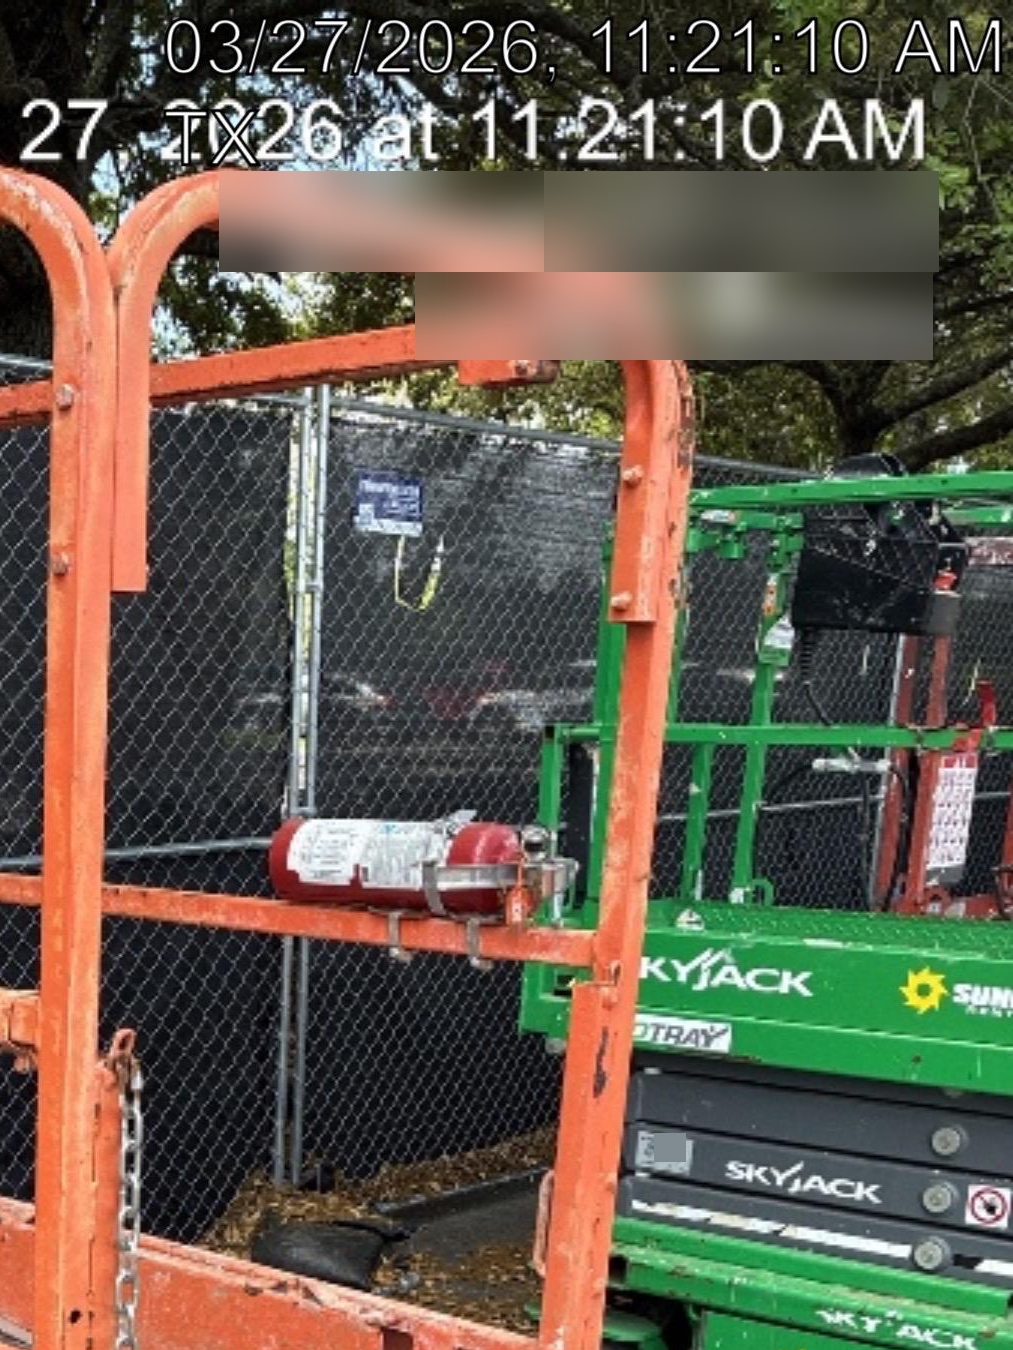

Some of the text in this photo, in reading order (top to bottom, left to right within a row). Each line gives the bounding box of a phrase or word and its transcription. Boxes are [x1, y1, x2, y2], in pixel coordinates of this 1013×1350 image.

[638, 948, 814, 998] KYJACK
[633, 1021, 730, 1049] OTRAY
[724, 1160, 883, 1204] SKYJACK
